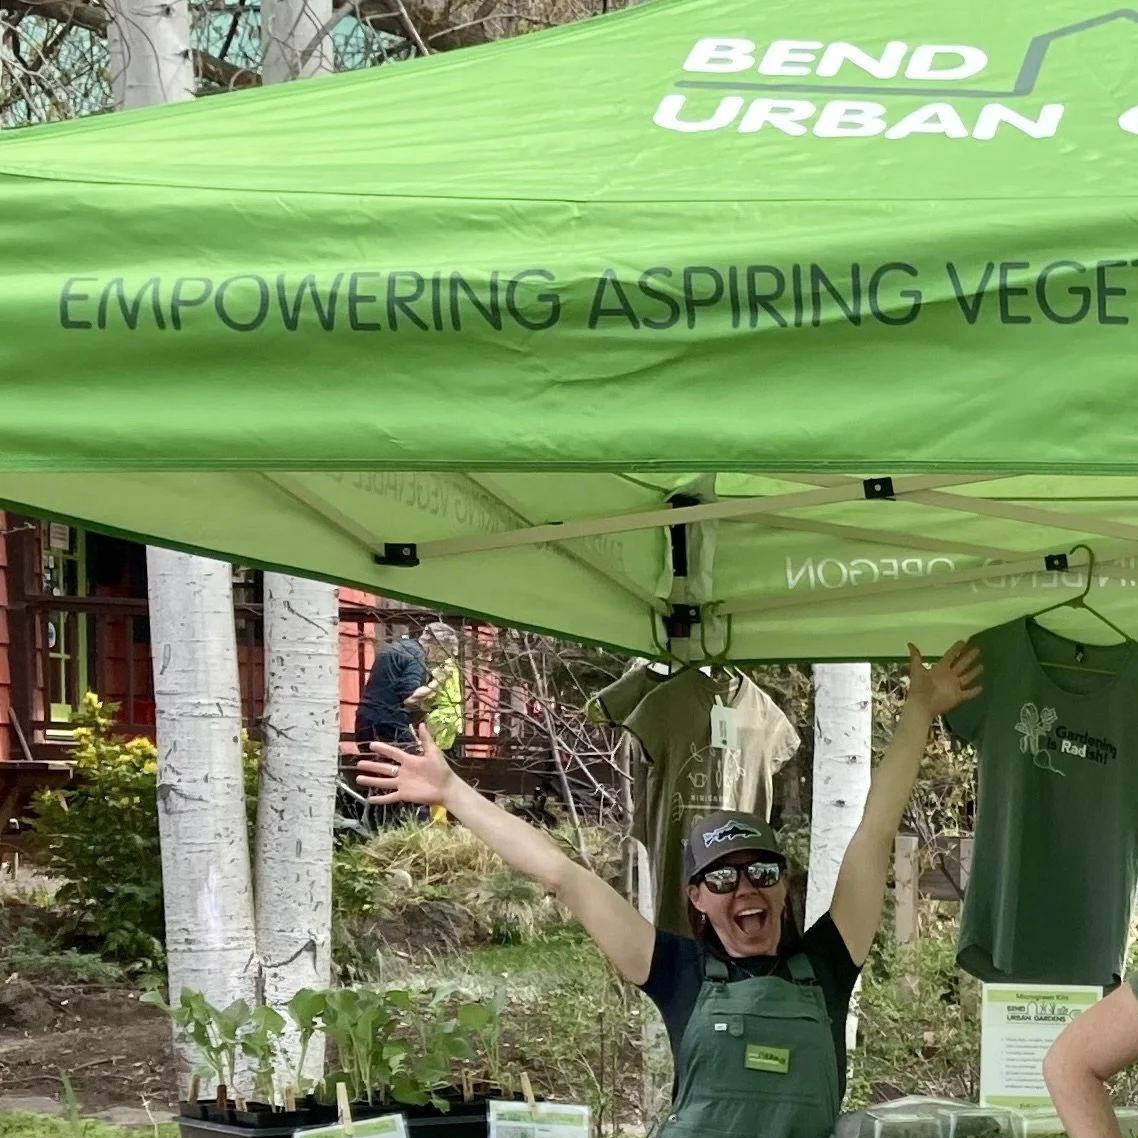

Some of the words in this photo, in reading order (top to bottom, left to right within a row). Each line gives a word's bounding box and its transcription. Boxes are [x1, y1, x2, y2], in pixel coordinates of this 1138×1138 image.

[682, 38, 988, 80] BEND
[653, 94, 1064, 140] URBAN
[59, 269, 561, 331] EMPOWERING
[588, 262, 921, 331] ASPIRING
[1055, 725, 1118, 760] Gardening
